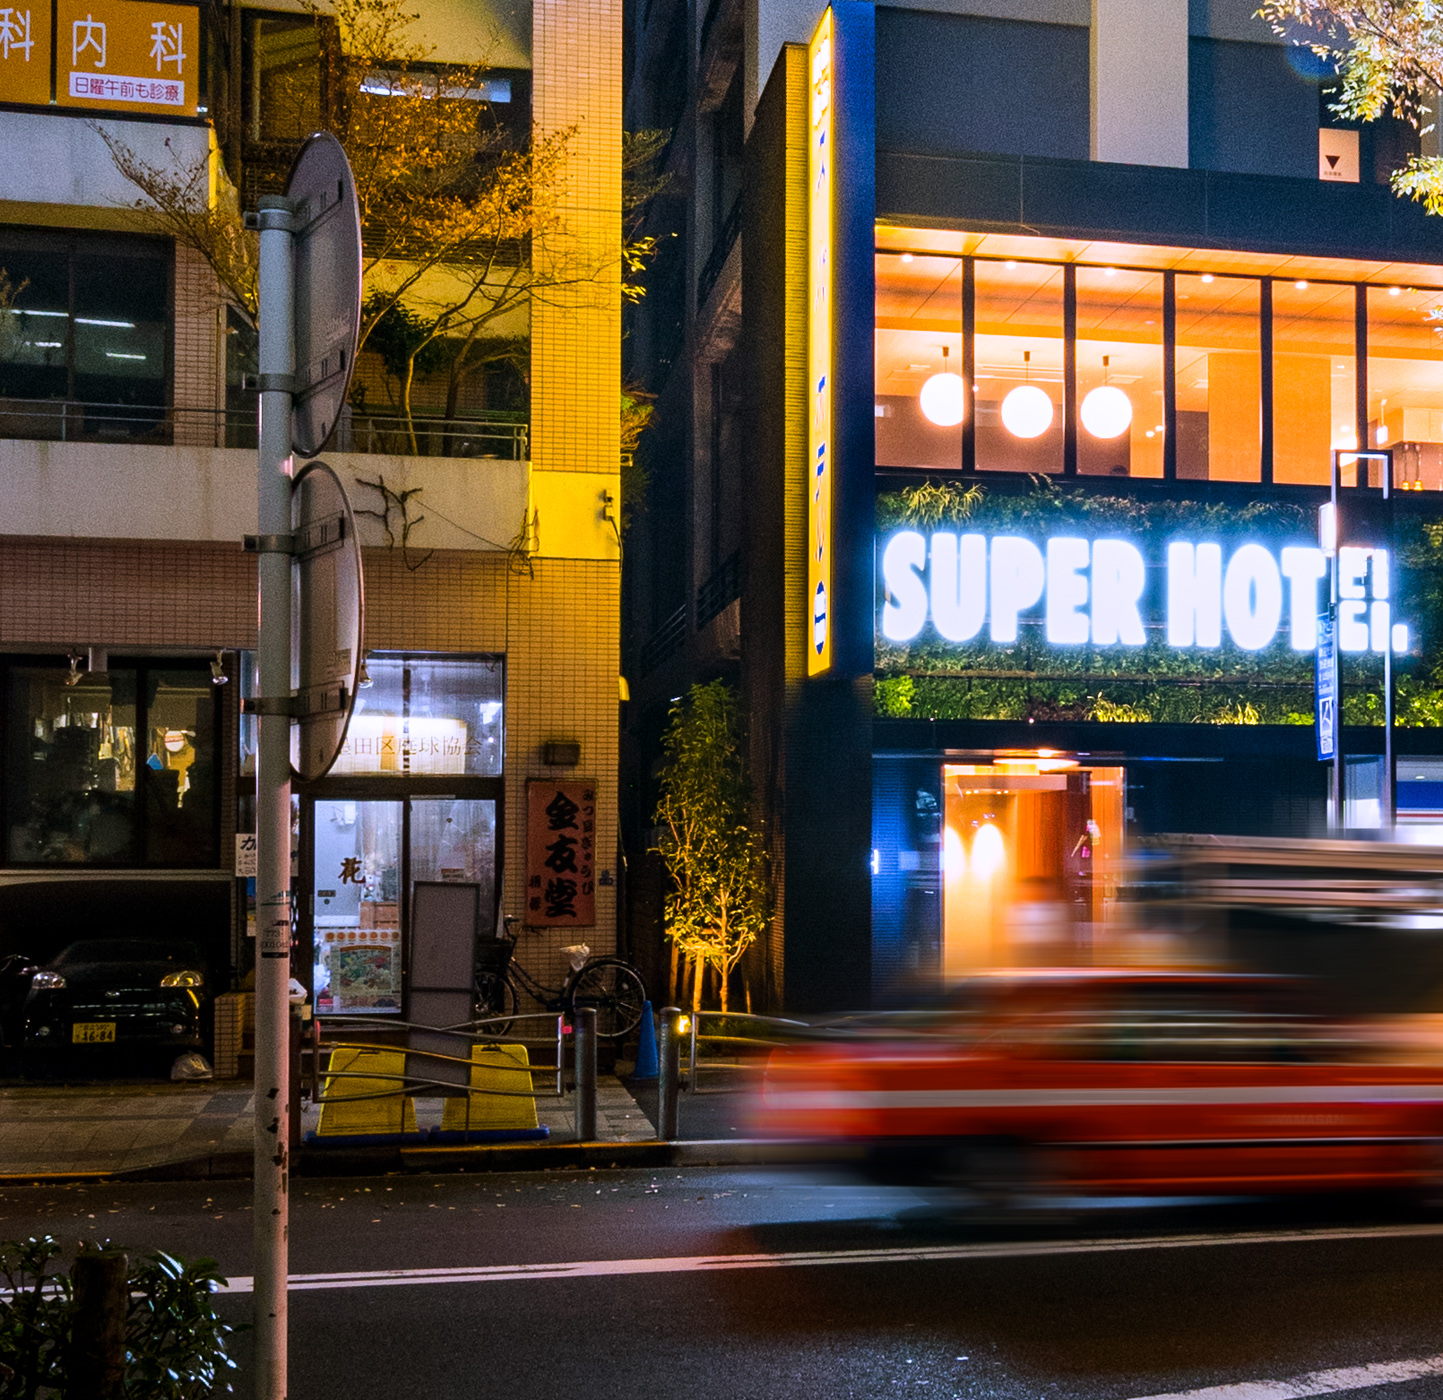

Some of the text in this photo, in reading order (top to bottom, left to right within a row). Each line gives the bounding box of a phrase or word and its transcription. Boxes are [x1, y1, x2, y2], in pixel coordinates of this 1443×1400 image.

[72, 13, 187, 75] 内科
[74, 76, 180, 102] 日曜午前も診療
[882, 531, 1409, 653] SUPER HOTEL
[338, 856, 367, 885] 花
[544, 790, 580, 918] 金友堂
